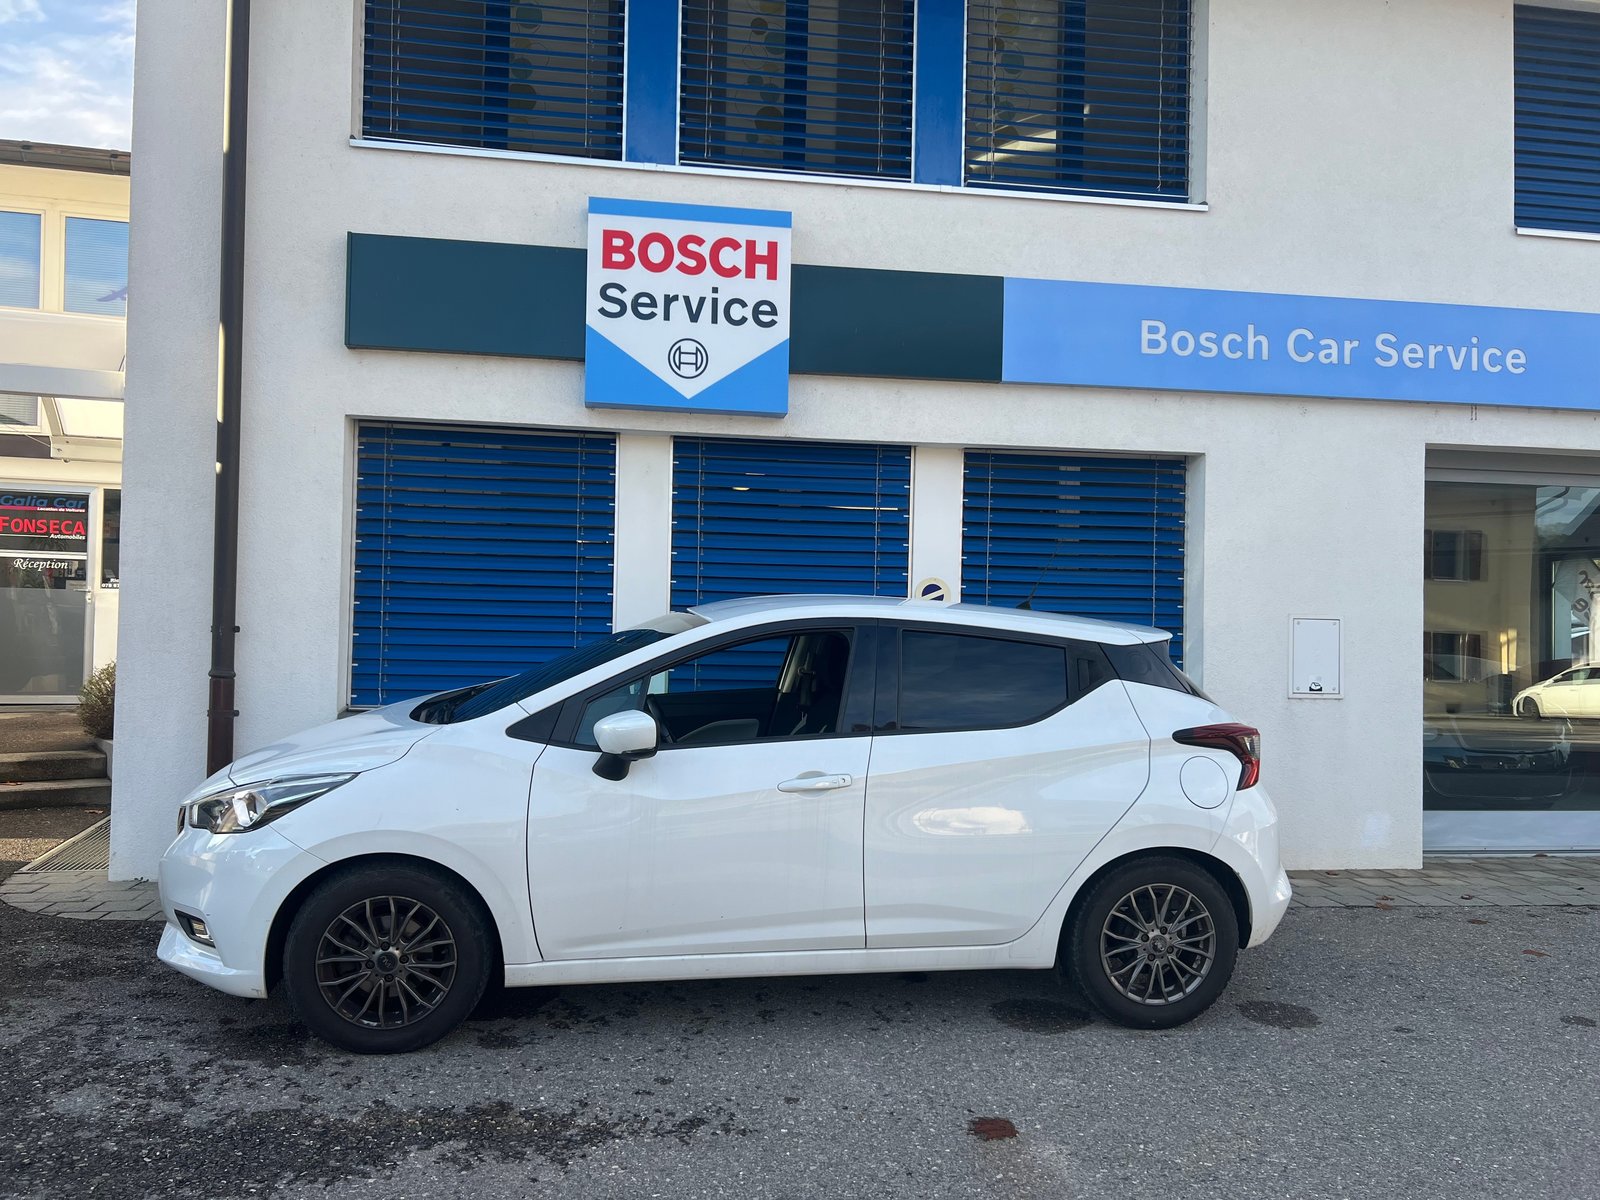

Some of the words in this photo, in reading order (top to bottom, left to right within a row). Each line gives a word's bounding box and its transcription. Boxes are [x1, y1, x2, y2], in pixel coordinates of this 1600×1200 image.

[602, 229, 778, 281] BOSCH
[597, 282, 778, 328] Service
[1140, 319, 1269, 360] Bosch
[1286, 328, 1359, 365] Car
[1374, 332, 1527, 375] Service
[54, 497, 86, 508] Car
[0, 516, 86, 535] FONSECA
[14, 558, 68, 571] Réception
